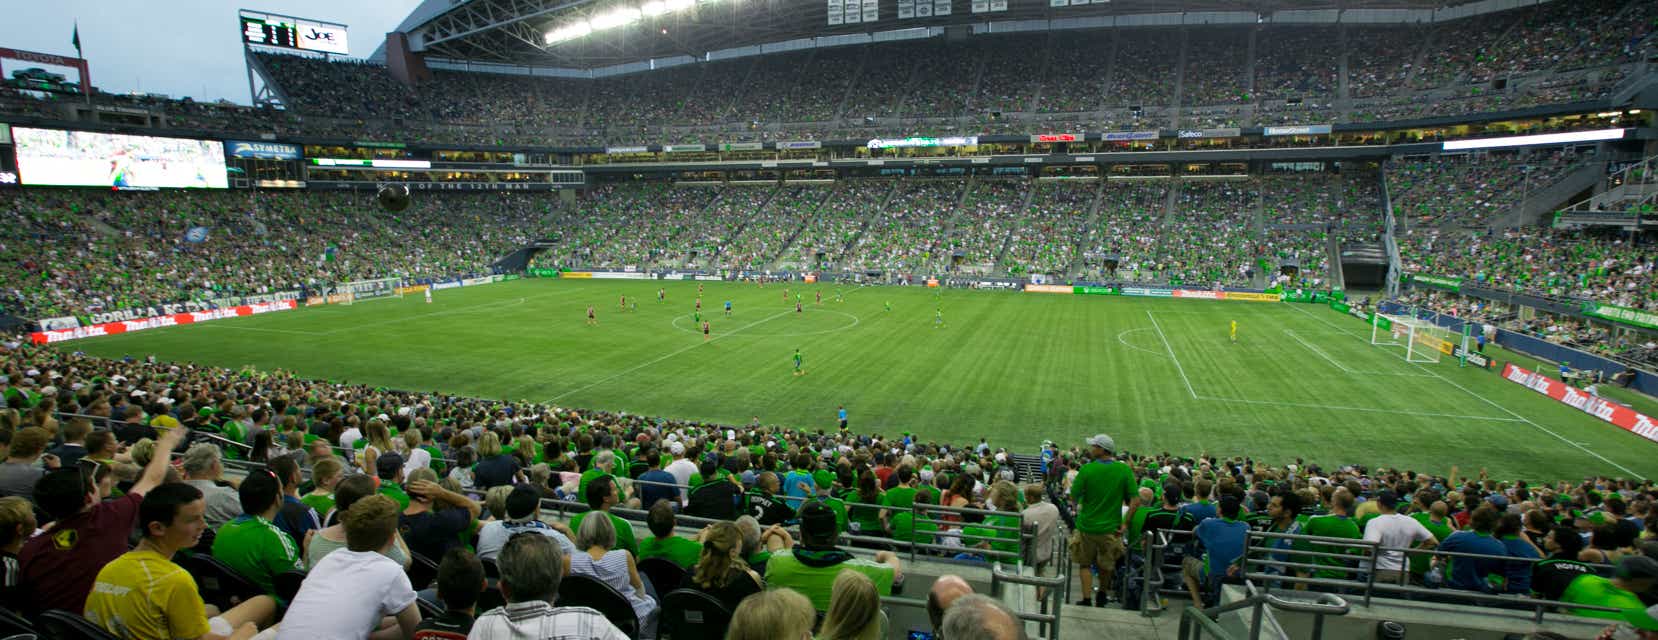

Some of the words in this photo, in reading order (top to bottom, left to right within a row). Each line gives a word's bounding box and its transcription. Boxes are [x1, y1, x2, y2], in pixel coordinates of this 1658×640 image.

[15, 51, 65, 65] TOYOTA
[1180, 130, 1203, 138] Safeco
[252, 143, 297, 154] SYMETRA
